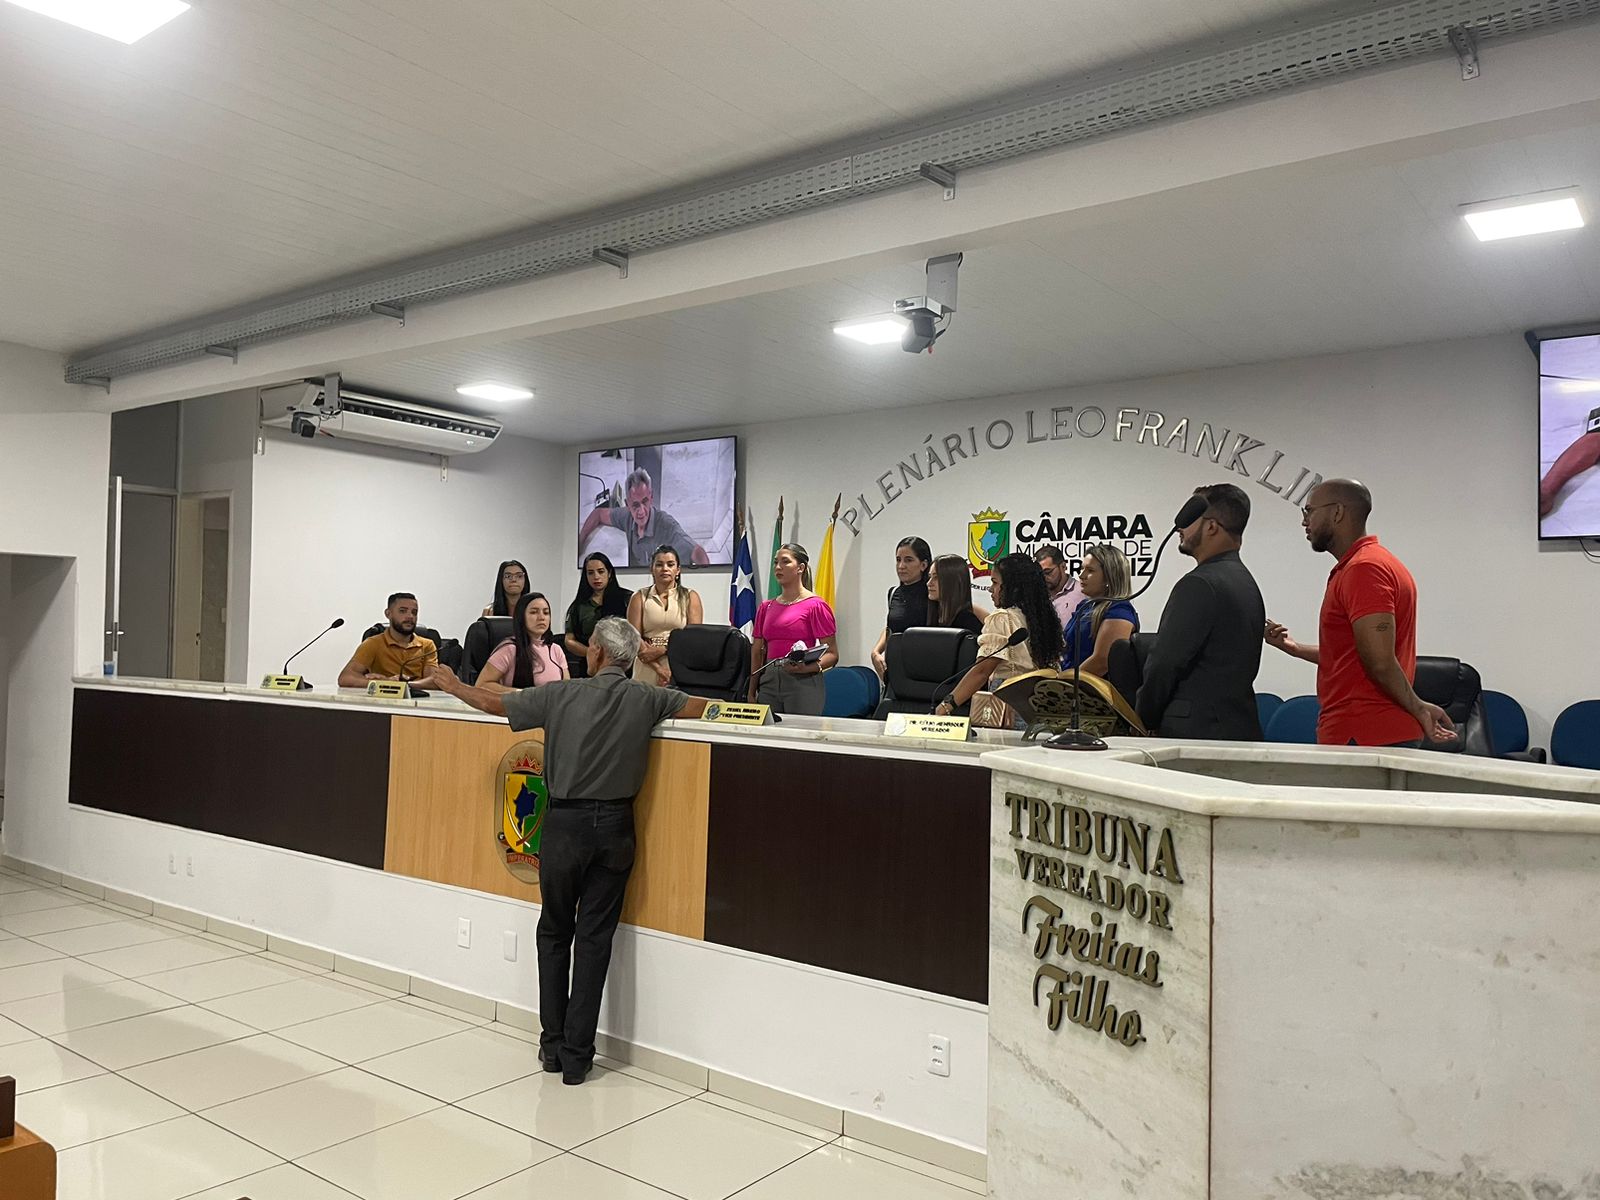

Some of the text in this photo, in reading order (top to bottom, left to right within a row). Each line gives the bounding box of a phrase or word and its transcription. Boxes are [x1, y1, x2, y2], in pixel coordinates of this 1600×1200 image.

[839, 419, 1014, 537] PLENÁRIO
[1026, 406, 1106, 443] LEO
[1015, 512, 1153, 543] CÂMARA
[1125, 540, 1152, 557] DE
[1005, 791, 1184, 884] TRIBUNA
[1014, 849, 1173, 931] VEREADOR
[1022, 895, 1163, 988] Freitas
[1032, 963, 1147, 1047] Filho
